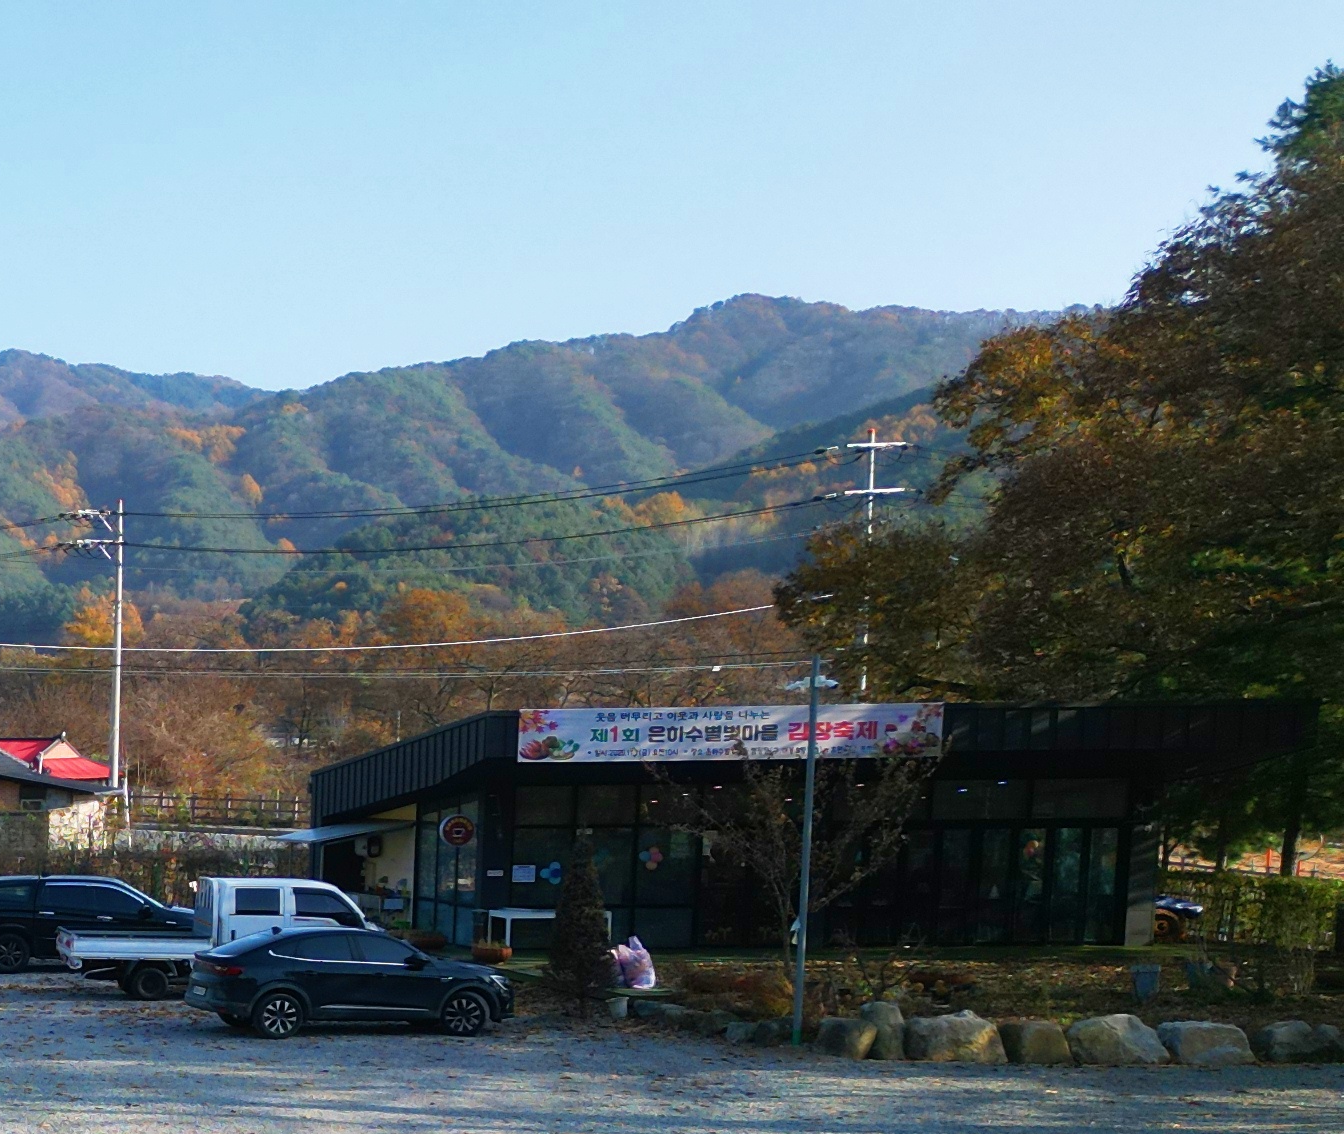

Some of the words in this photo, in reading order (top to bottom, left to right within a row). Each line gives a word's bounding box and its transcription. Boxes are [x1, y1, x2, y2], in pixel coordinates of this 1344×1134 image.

[620, 711, 663, 721] 버무리고
[667, 711, 698, 721] 이웃과
[702, 710, 733, 720] 사랑을
[738, 710, 770, 720] 나누는
[590, 725, 640, 742] 제1회
[648, 724, 778, 742] 은하수별빛마을
[788, 720, 878, 741] 김장축제
